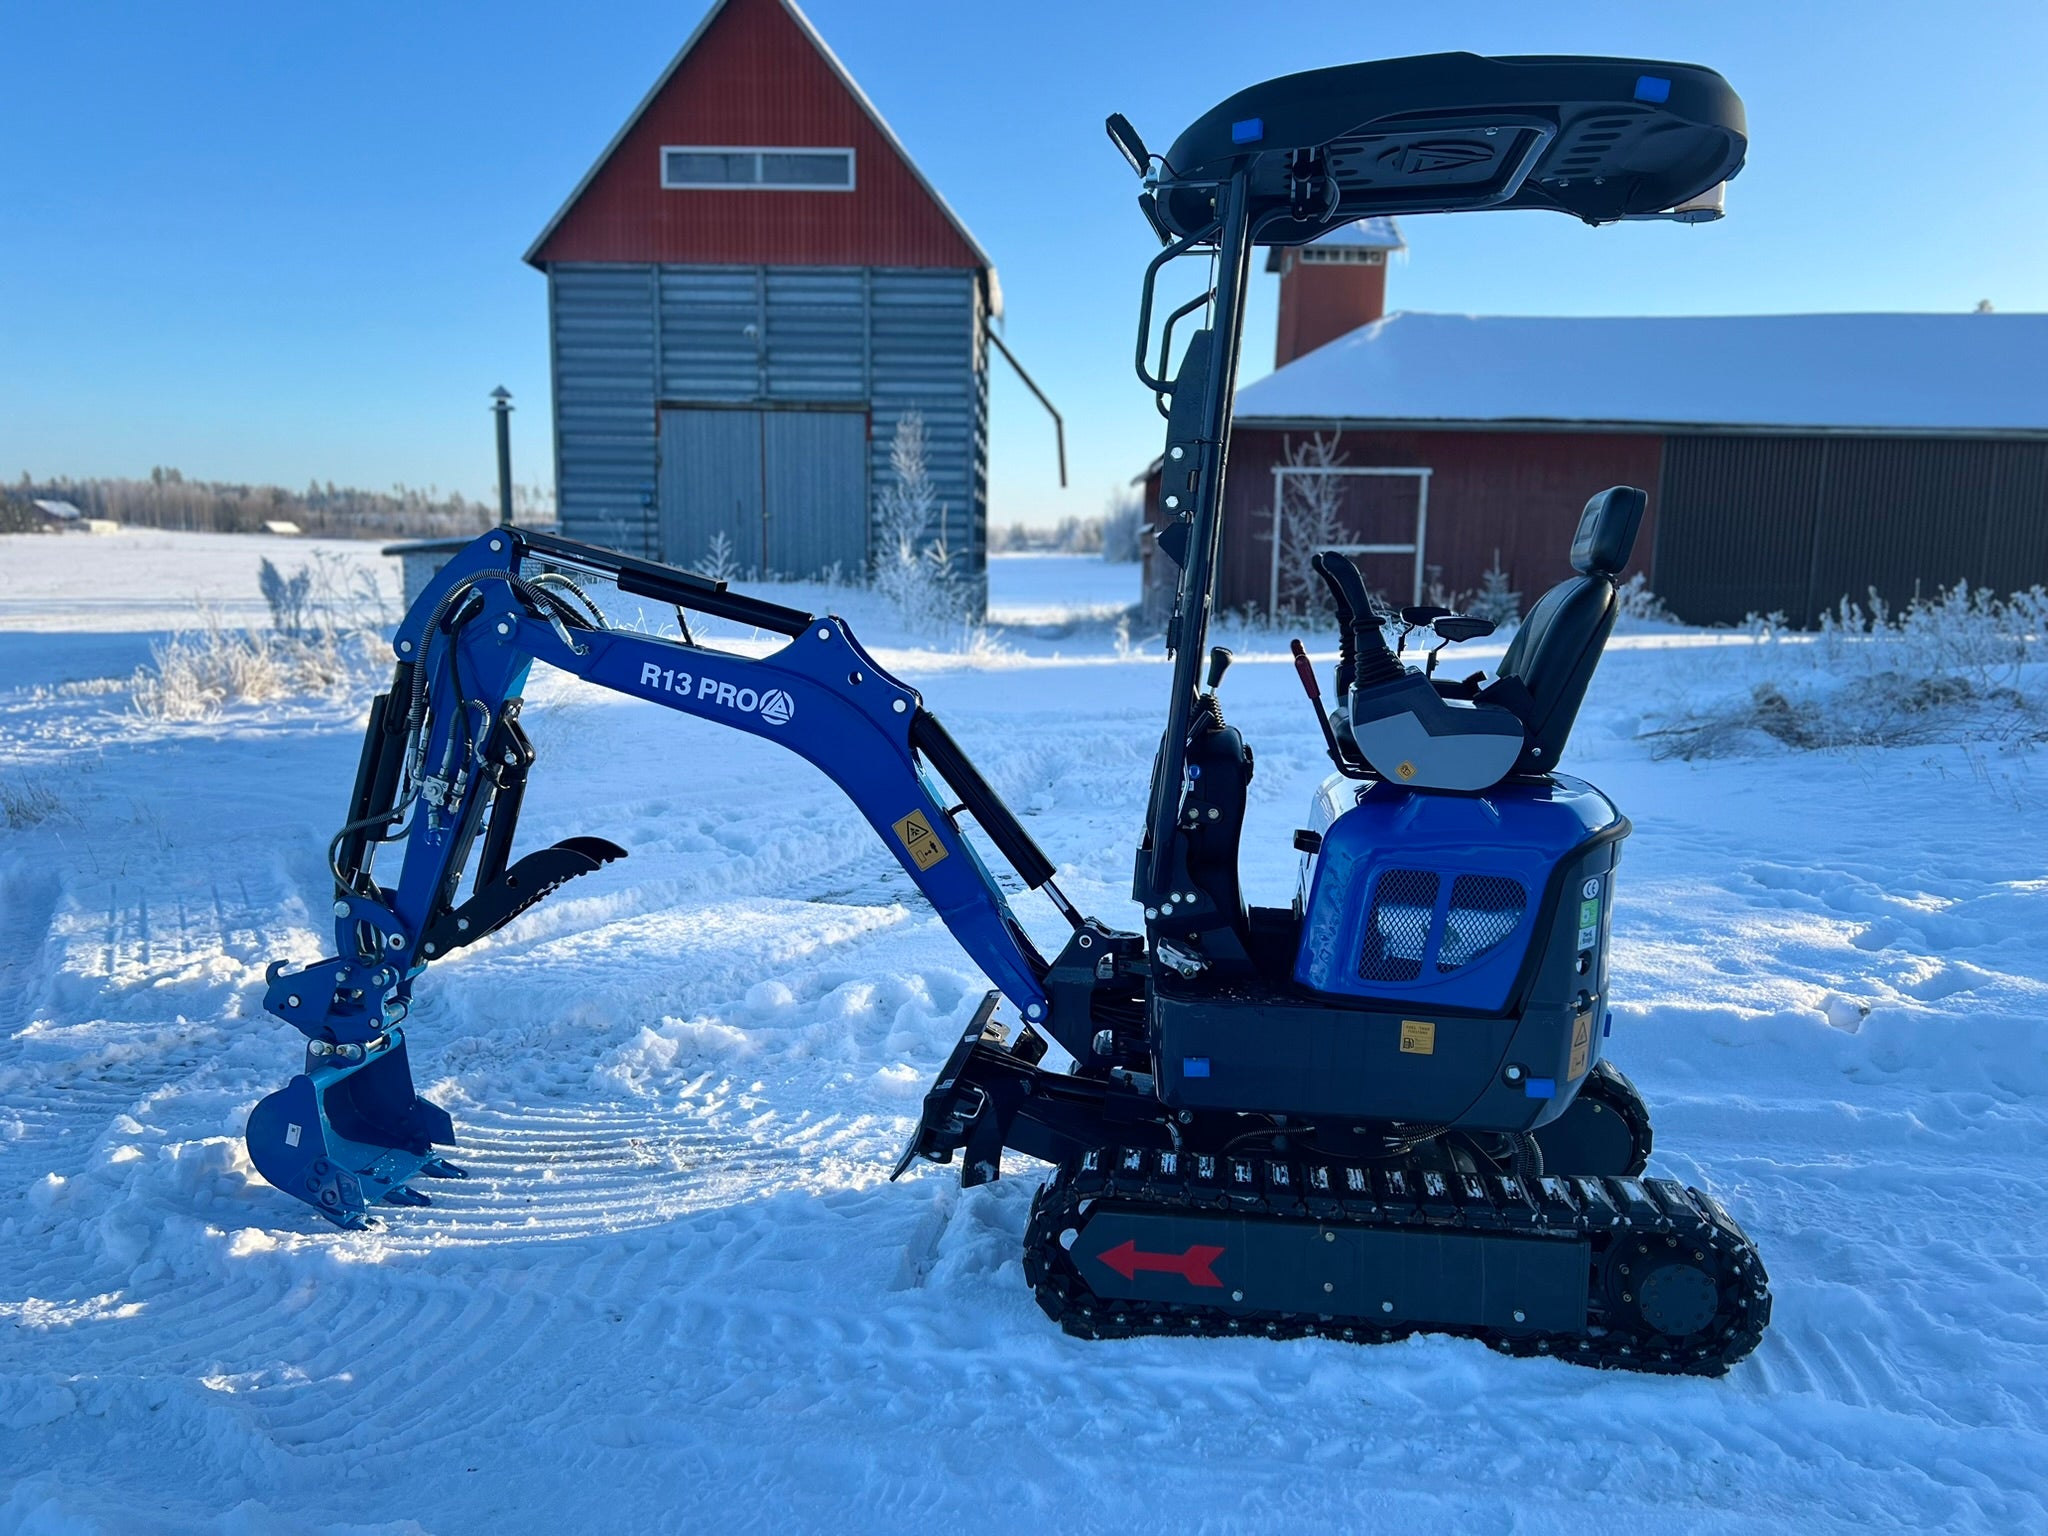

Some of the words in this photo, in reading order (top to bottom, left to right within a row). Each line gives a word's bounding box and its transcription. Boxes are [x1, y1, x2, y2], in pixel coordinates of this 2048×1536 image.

[640, 662, 692, 695] R13
[697, 677, 759, 712] PRO
[1587, 881, 1597, 896] CE
